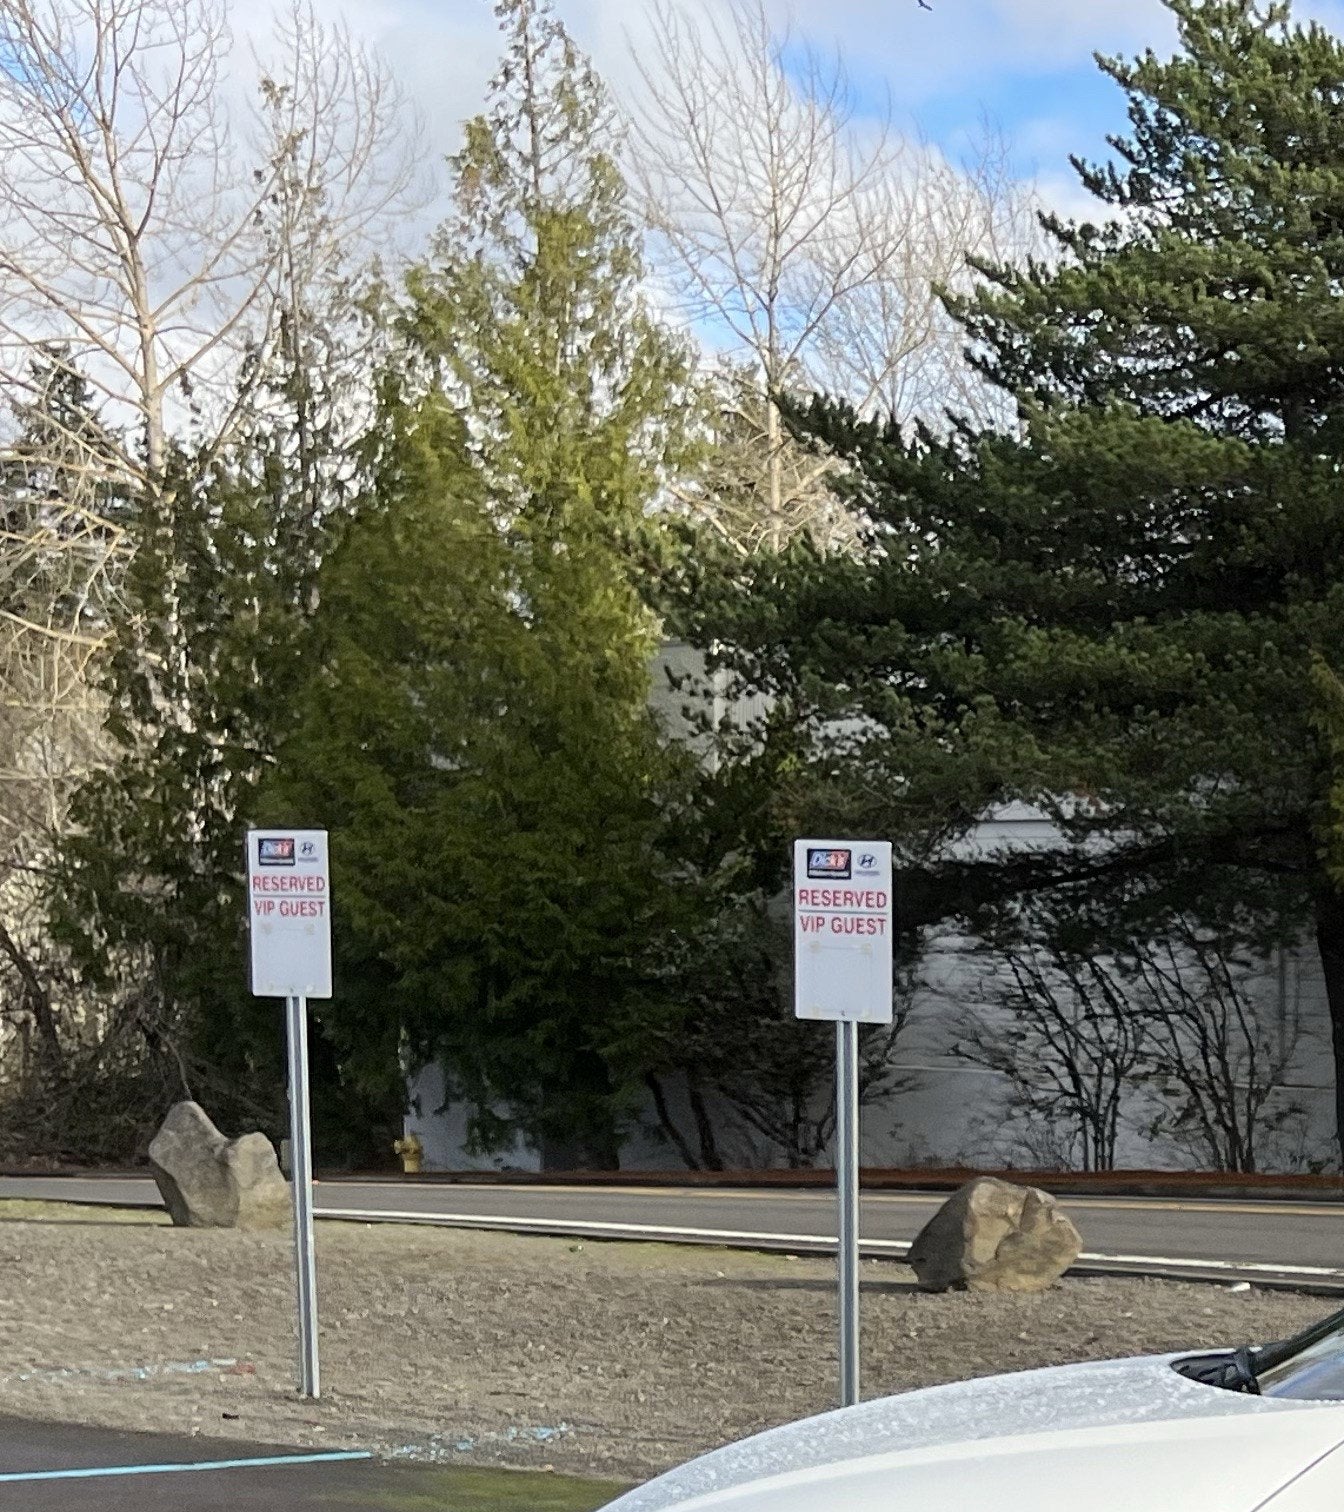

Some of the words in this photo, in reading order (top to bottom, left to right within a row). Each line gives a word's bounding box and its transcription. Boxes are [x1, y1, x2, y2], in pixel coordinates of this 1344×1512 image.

[252, 875, 326, 892] RESERVED
[254, 900, 275, 916] VIP
[279, 900, 326, 916] GUEST
[799, 888, 888, 909] RESERVED
[800, 915, 826, 933] VIP
[831, 916, 887, 936] GUEST
